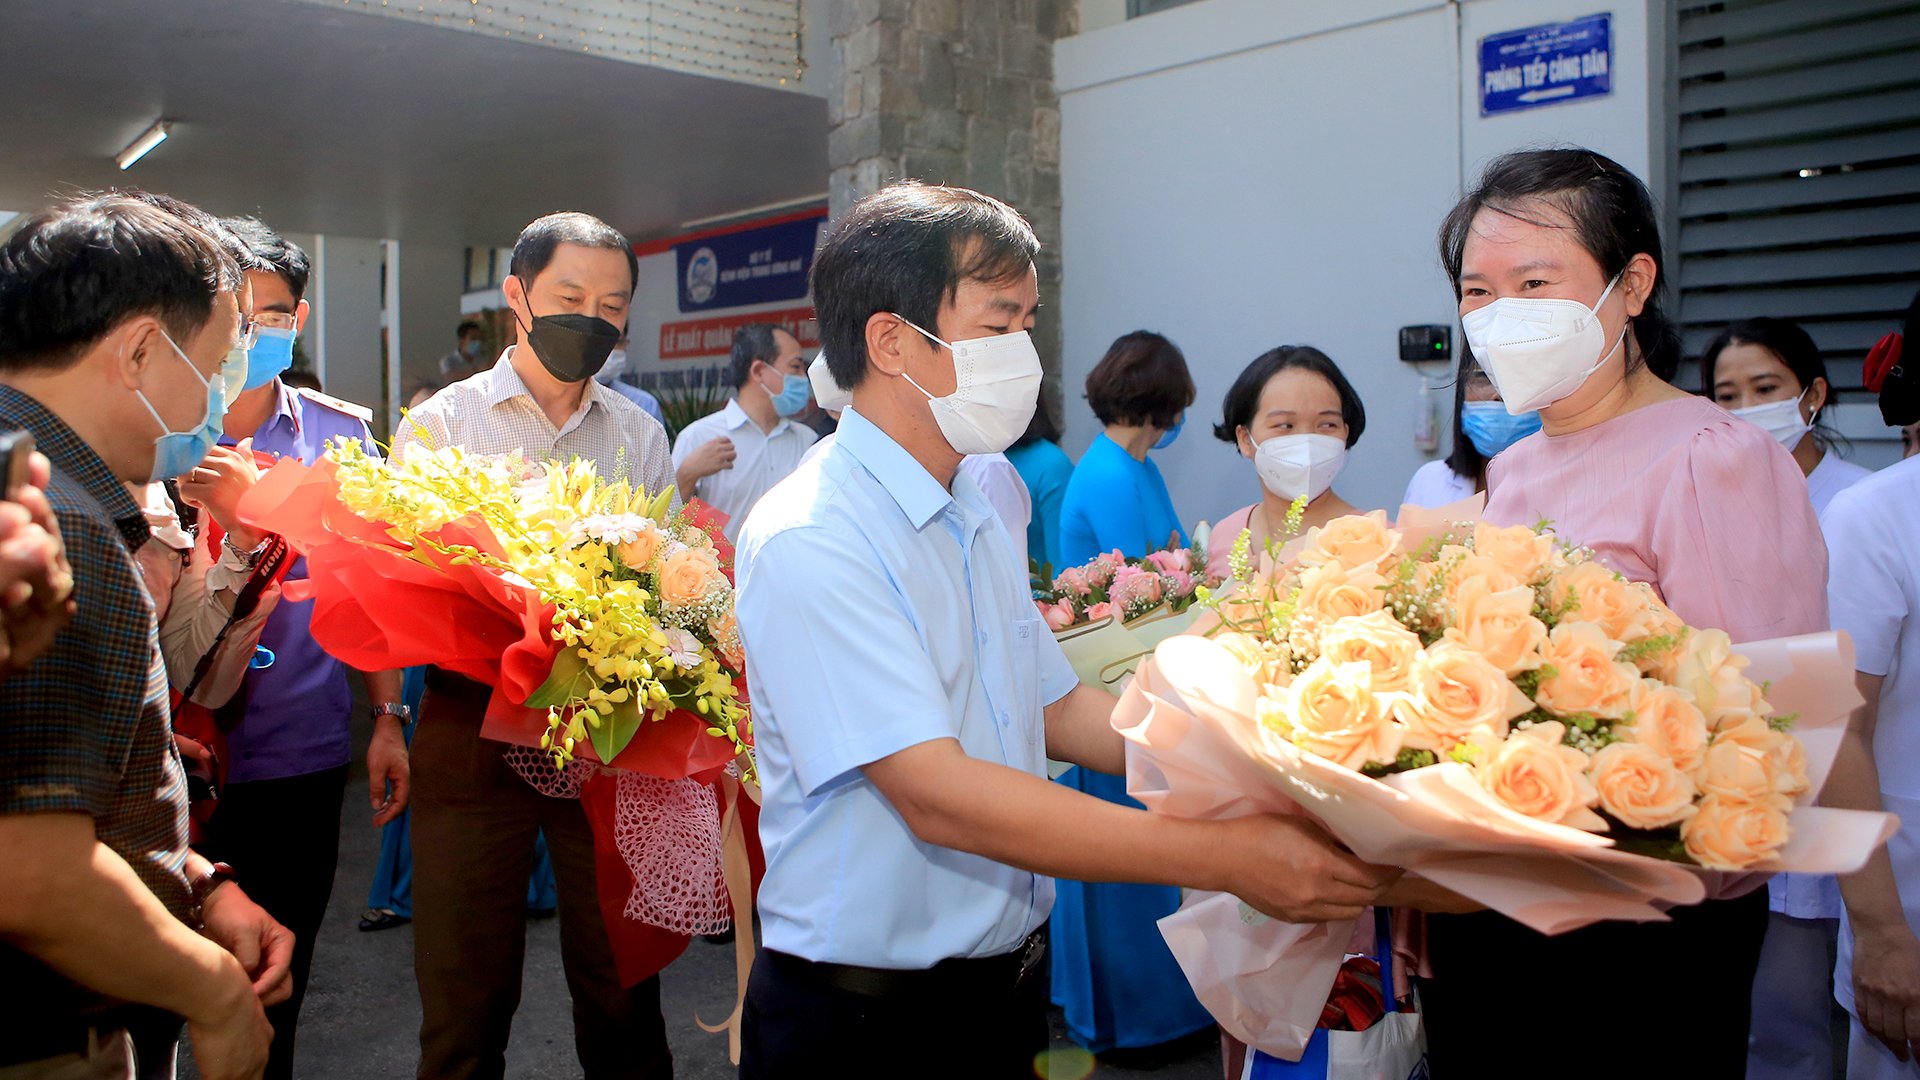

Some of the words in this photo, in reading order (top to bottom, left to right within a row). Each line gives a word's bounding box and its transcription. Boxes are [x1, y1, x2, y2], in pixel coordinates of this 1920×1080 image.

[1485, 63, 1523, 95] PHÒNG
[1523, 55, 1548, 88] TIẾP
[1549, 53, 1582, 83] CÔNG
[1582, 48, 1608, 78] DÂN
